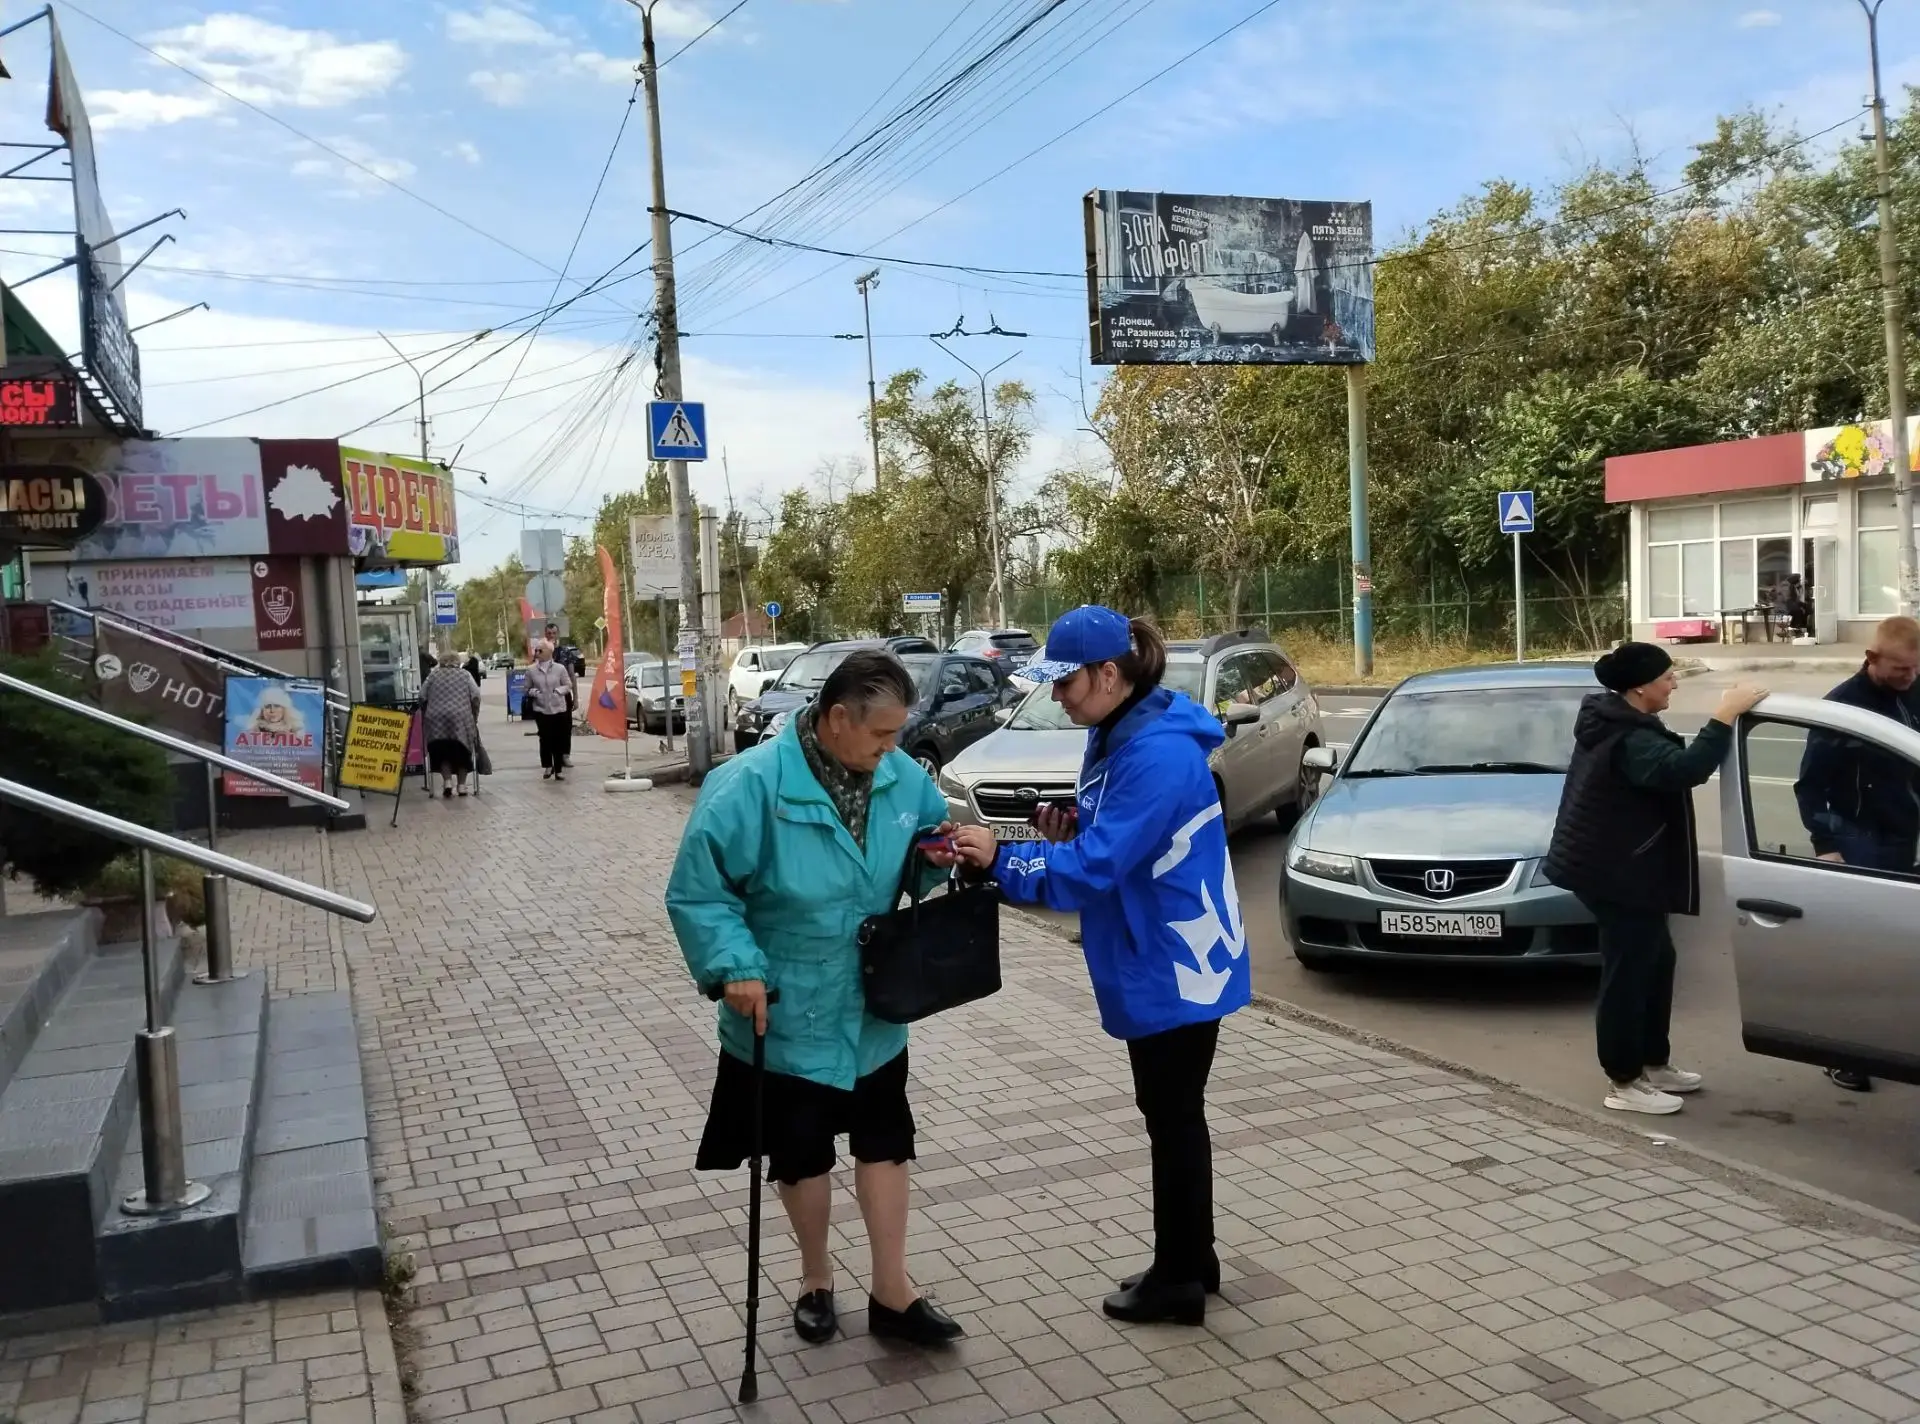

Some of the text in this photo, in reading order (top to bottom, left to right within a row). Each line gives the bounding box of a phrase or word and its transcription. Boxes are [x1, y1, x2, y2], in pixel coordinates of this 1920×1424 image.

[1122, 214, 1169, 250] ЗОНА
[1171, 224, 1200, 236] ПЛИТКА
[1312, 225, 1363, 235] ПЯТЬ ЗВЕЗД
[1129, 238, 1224, 283] КОМФОРТА
[1119, 316, 1155, 326] Донецк,
[1111, 328, 1190, 338] ул. Разенкова, 12
[1112, 339, 1201, 348] тел.: 7 949 340 20 55
[346, 460, 458, 542] ЦВЕТЫ
[97, 565, 215, 581] ПРИНИМАЕМ
[99, 583, 174, 598] ЗАКАЗЫ
[135, 594, 250, 612] СВАДЕБНЫЕ
[260, 628, 304, 639] НОТАРИУС
[161, 678, 225, 718] НОТ
[356, 714, 405, 729] СМАРТФОНЫ
[235, 732, 313, 747] АТЕЛЬЕ
[356, 726, 400, 741] ПЛАНШЕТЫ
[350, 738, 401, 753] АКСЕССУАРЫ
[1466, 916, 1496, 930] 180
